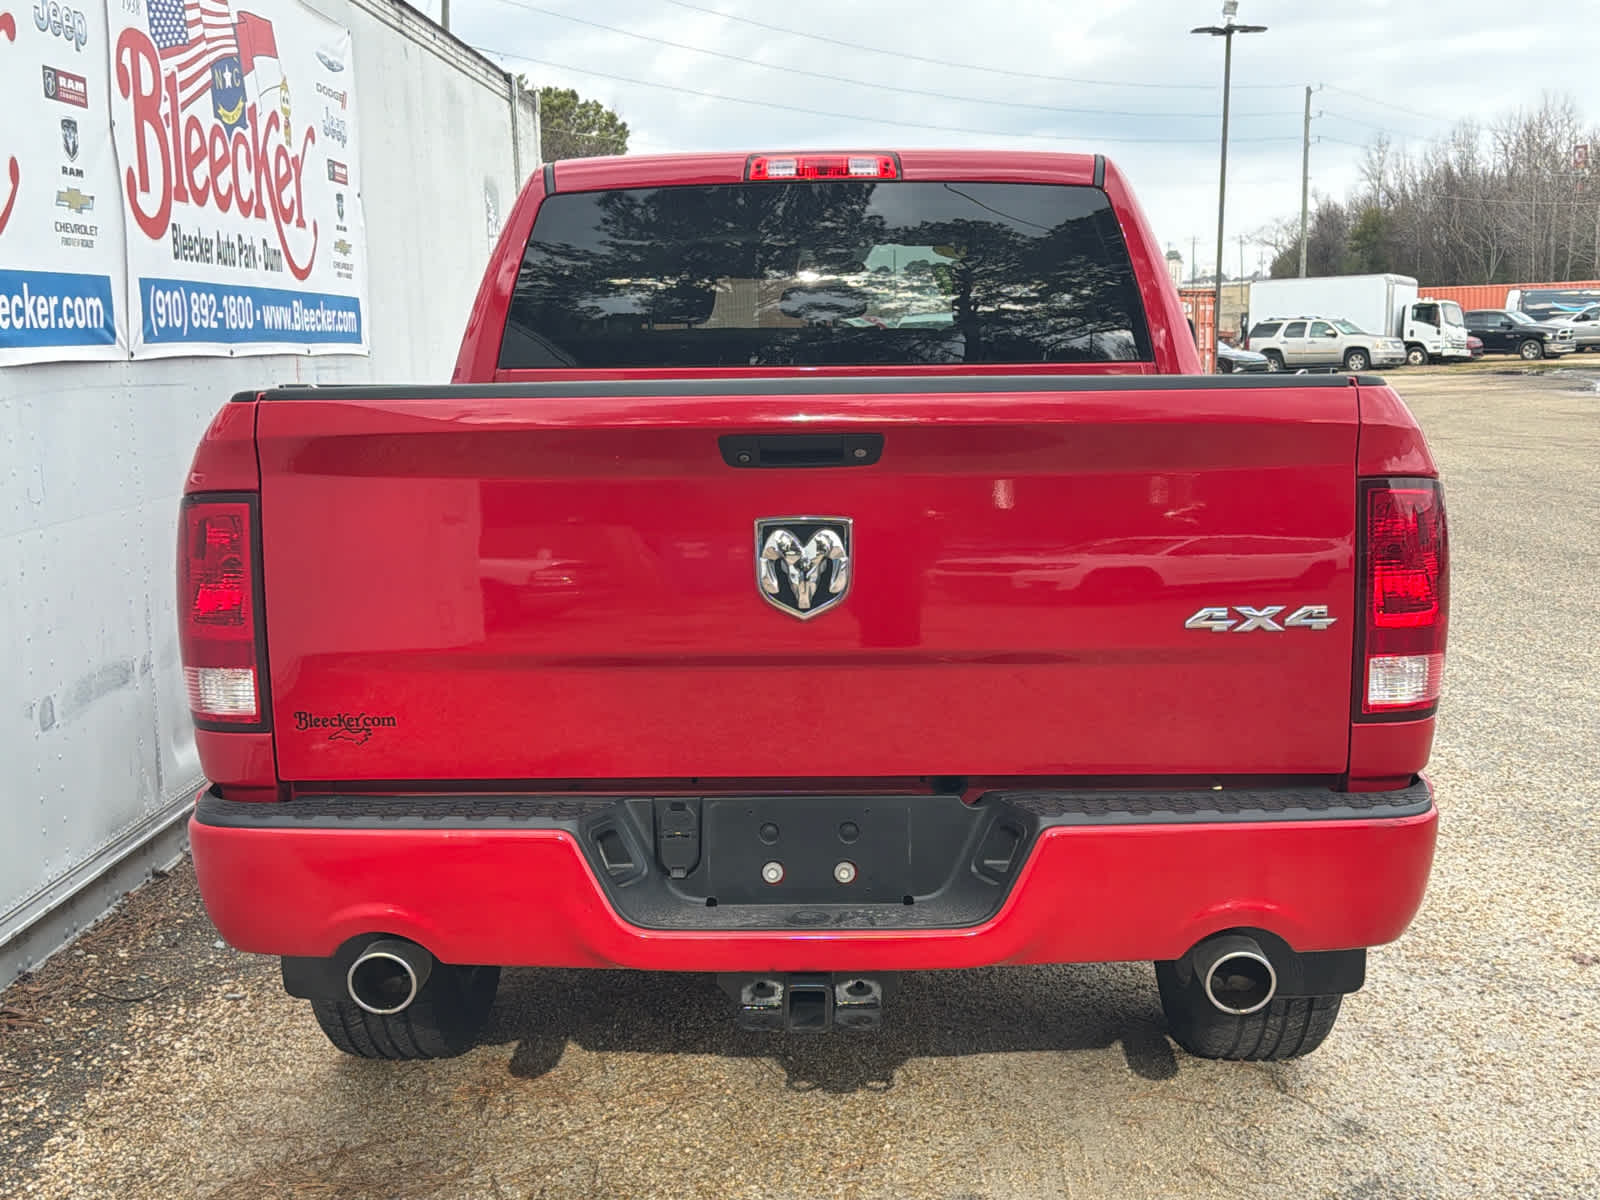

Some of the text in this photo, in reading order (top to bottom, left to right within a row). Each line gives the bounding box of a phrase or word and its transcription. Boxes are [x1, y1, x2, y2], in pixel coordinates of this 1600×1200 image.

[33, 0, 88, 52] Jeep
[58, 75, 85, 93] RAM
[61, 165, 84, 178] RAM
[116, 27, 318, 281] Bleecker
[54, 221, 98, 236] CHEVROLET
[171, 222, 283, 273] Bleecker Auto Park Dunn
[150, 285, 358, 337] (910) 892-1800 www.Bleecker.com
